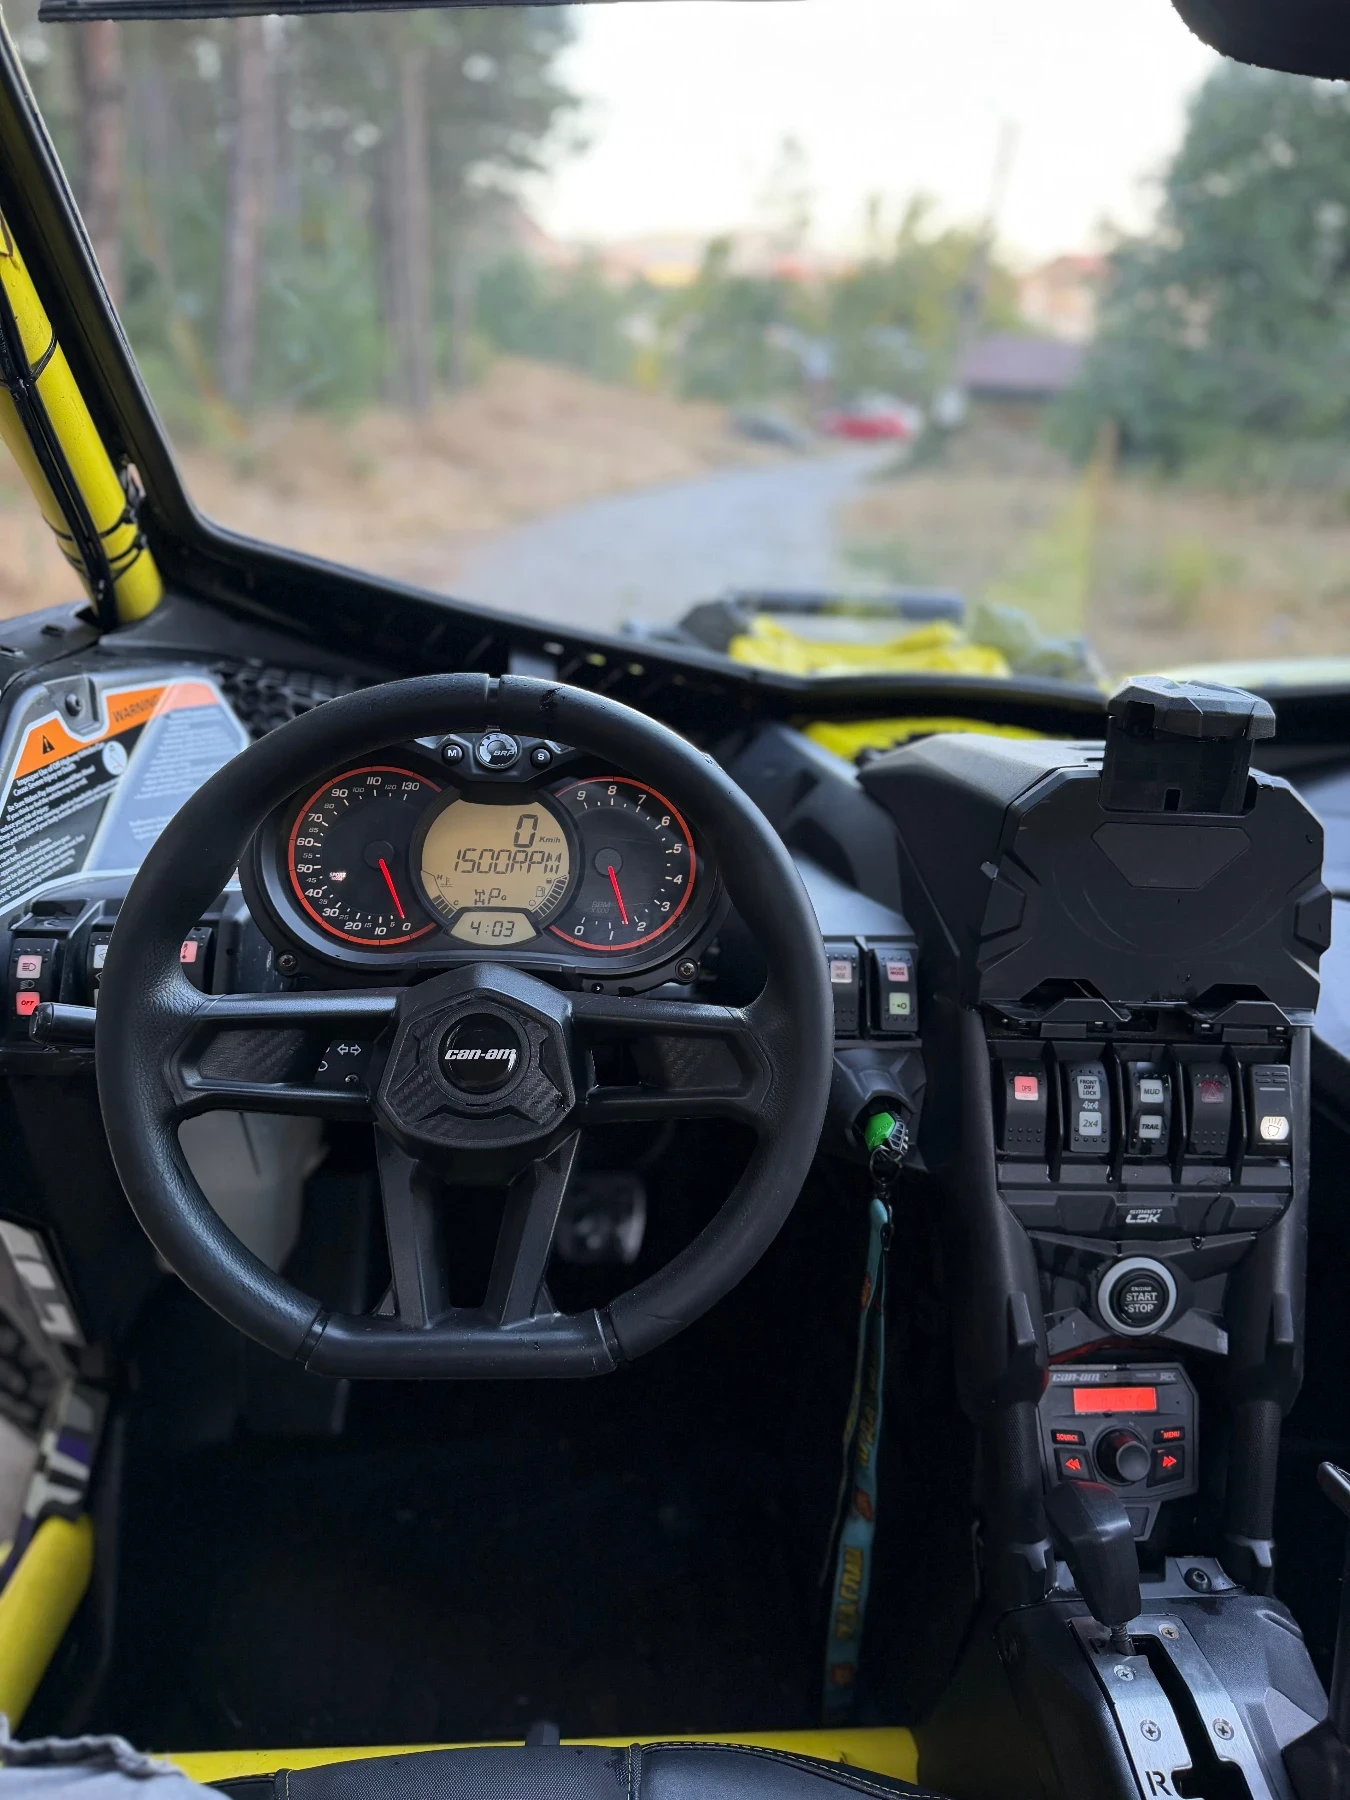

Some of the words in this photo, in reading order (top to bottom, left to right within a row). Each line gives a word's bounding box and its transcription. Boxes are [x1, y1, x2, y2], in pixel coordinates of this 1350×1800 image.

[367, 777, 382, 785] 110
[402, 782, 420, 791] 130
[607, 785, 617, 795] 8
[331, 788, 348, 797] 90
[576, 790, 586, 801] 9
[638, 795, 647, 804] 7
[308, 814, 323, 822] 70
[661, 816, 670, 826] 6
[513, 814, 539, 848] 0
[297, 838, 314, 847] 60
[673, 844, 682, 854] 5
[454, 849, 562, 874] 1500RPM
[297, 864, 313, 873] 50
[673, 875, 683, 884] 4
[305, 888, 322, 898] 40
[661, 902, 670, 912] 3
[322, 908, 339, 917] 30
[344, 922, 361, 930] 20
[402, 922, 411, 931] 0
[470, 921, 515, 937] 4:03
[574, 926, 584, 935] 0
[637, 922, 646, 931] 2
[374, 927, 386, 935] 10
[445, 1048, 517, 1067] can-am
[1126, 1292, 1158, 1302] START
[1127, 1304, 1154, 1313] STOP
[1052, 1373, 1100, 1382] can-am
[1056, 1433, 1079, 1442] SOURCE
[1164, 1430, 1180, 1438] MENU
[1145, 1770, 1173, 1797] R
